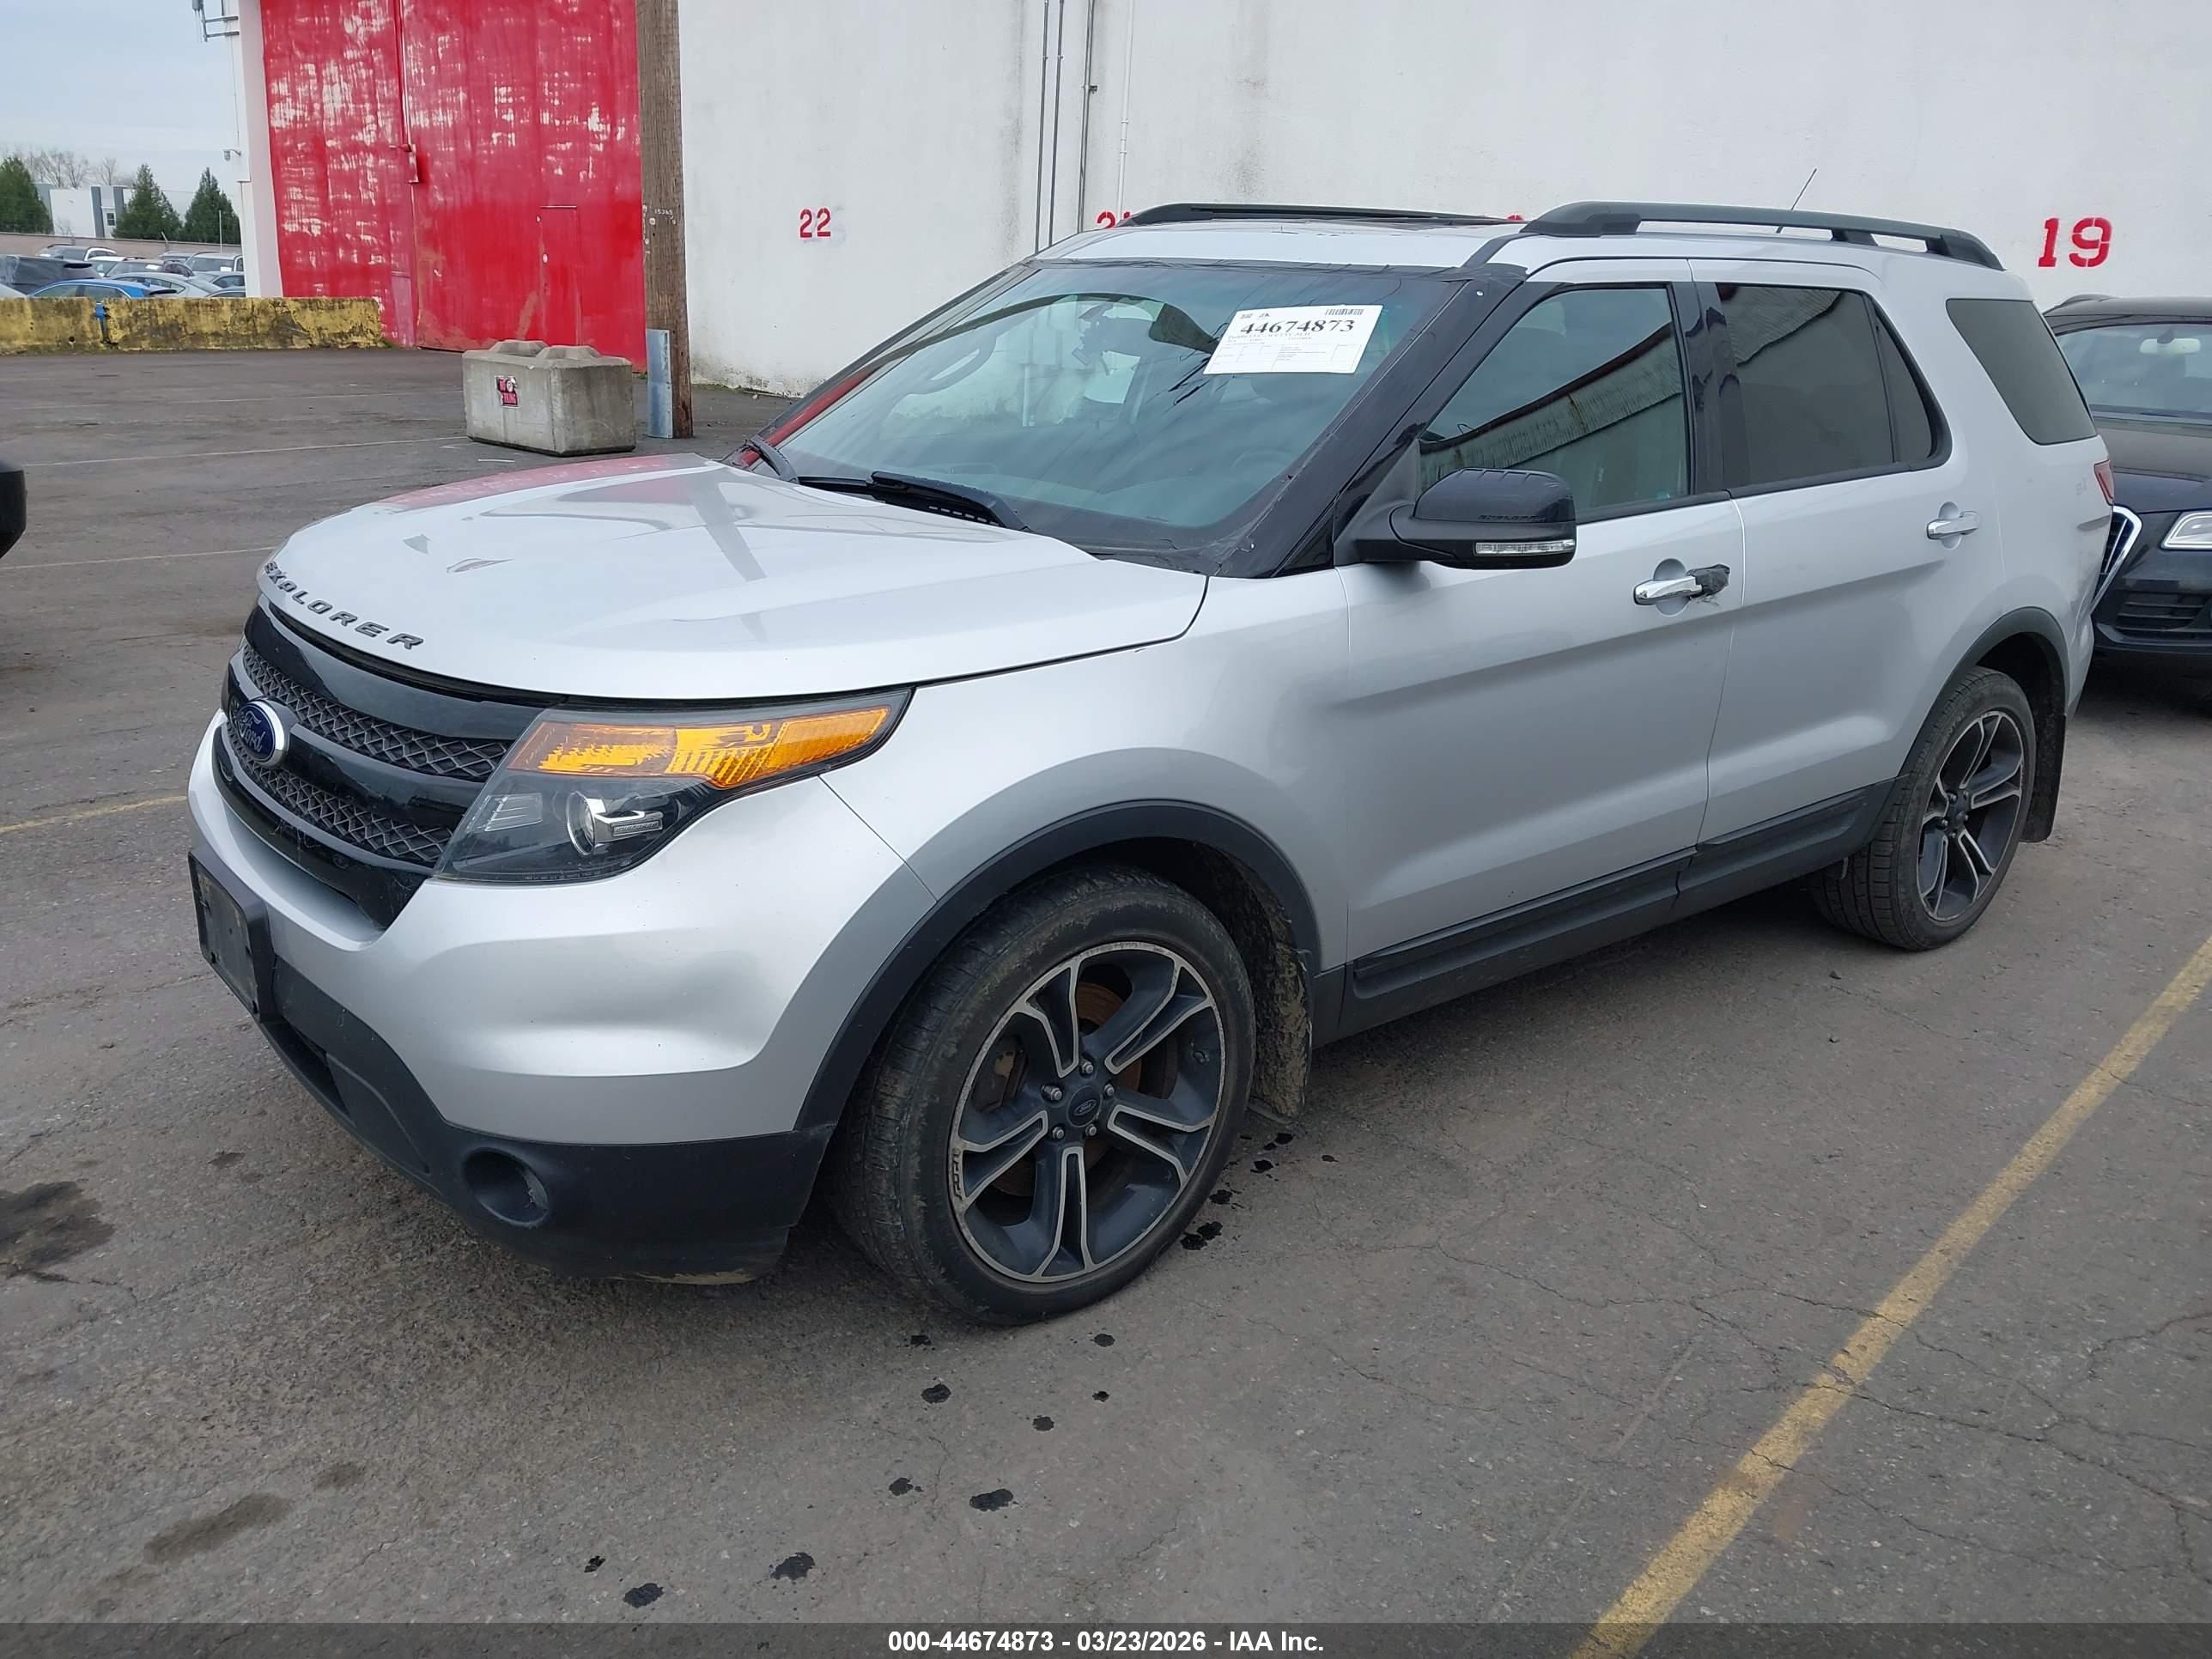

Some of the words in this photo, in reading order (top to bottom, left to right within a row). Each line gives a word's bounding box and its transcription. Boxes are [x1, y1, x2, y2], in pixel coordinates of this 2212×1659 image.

[799, 207, 831, 238] 22
[2038, 217, 2113, 267] 19
[1240, 319, 1355, 335] 44674873
[264, 561, 424, 650] EXPLORER
